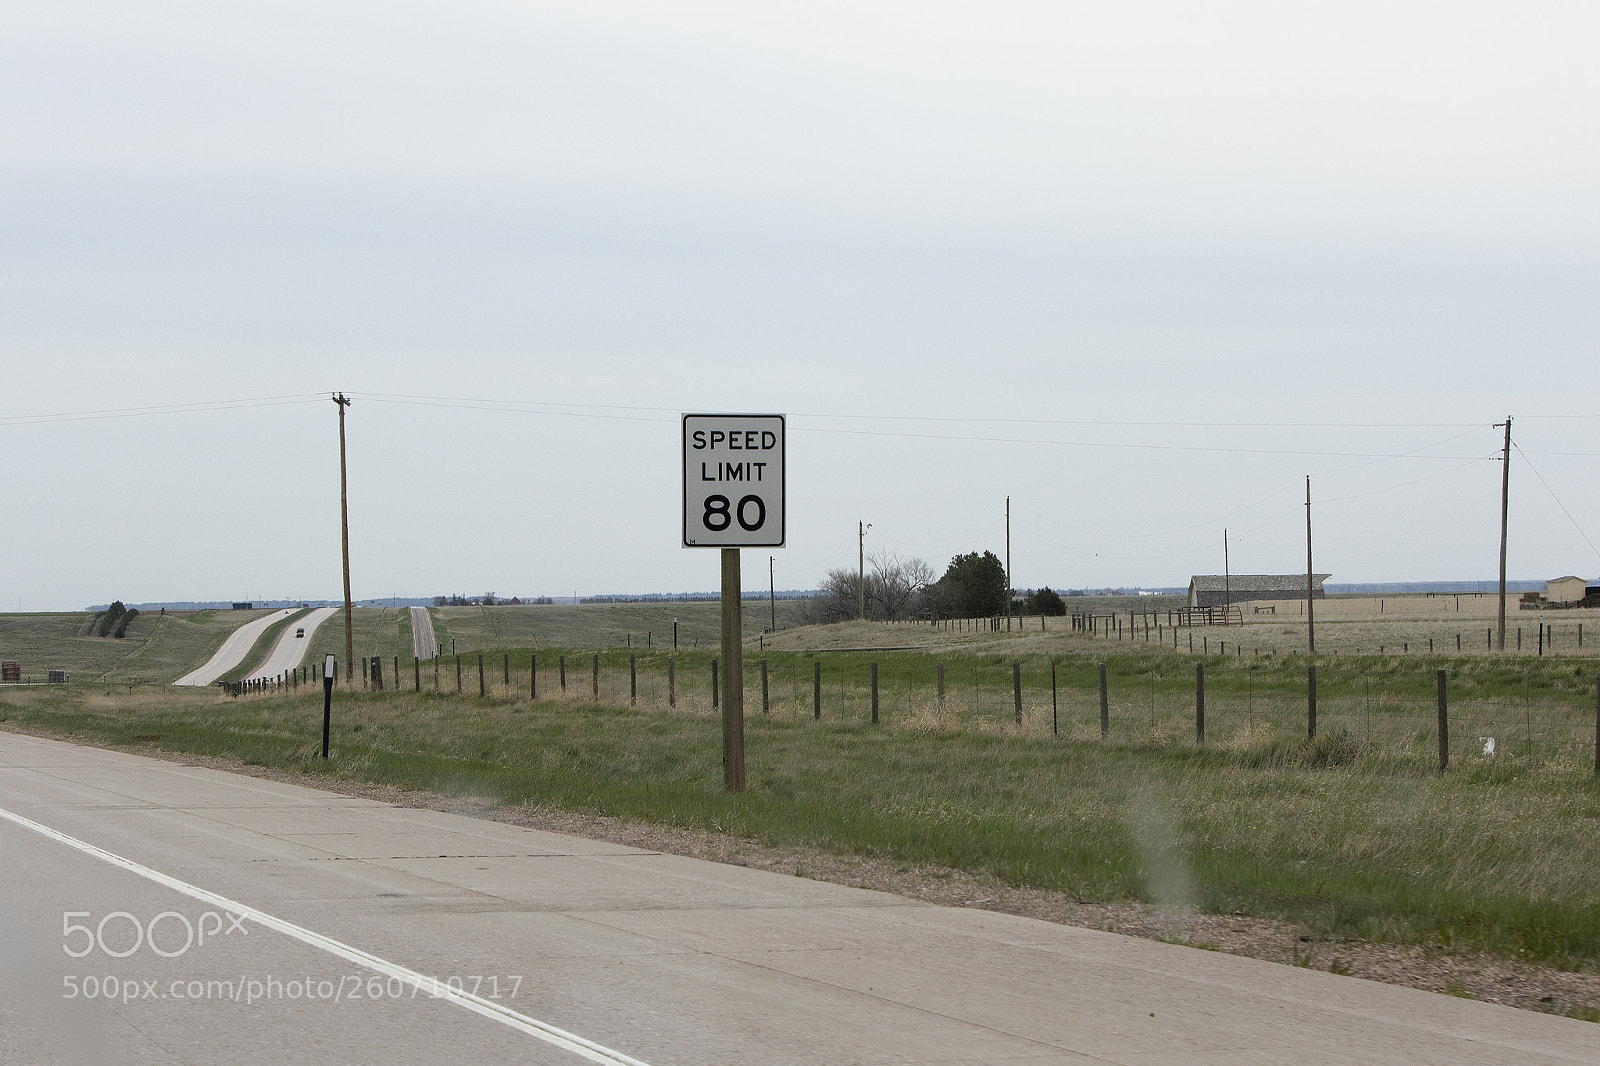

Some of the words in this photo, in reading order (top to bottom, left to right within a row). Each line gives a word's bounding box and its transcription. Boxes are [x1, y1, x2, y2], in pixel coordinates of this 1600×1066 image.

[692, 430, 777, 450] SPEED
[701, 462, 767, 482] LIMIT
[702, 494, 767, 532] 80
